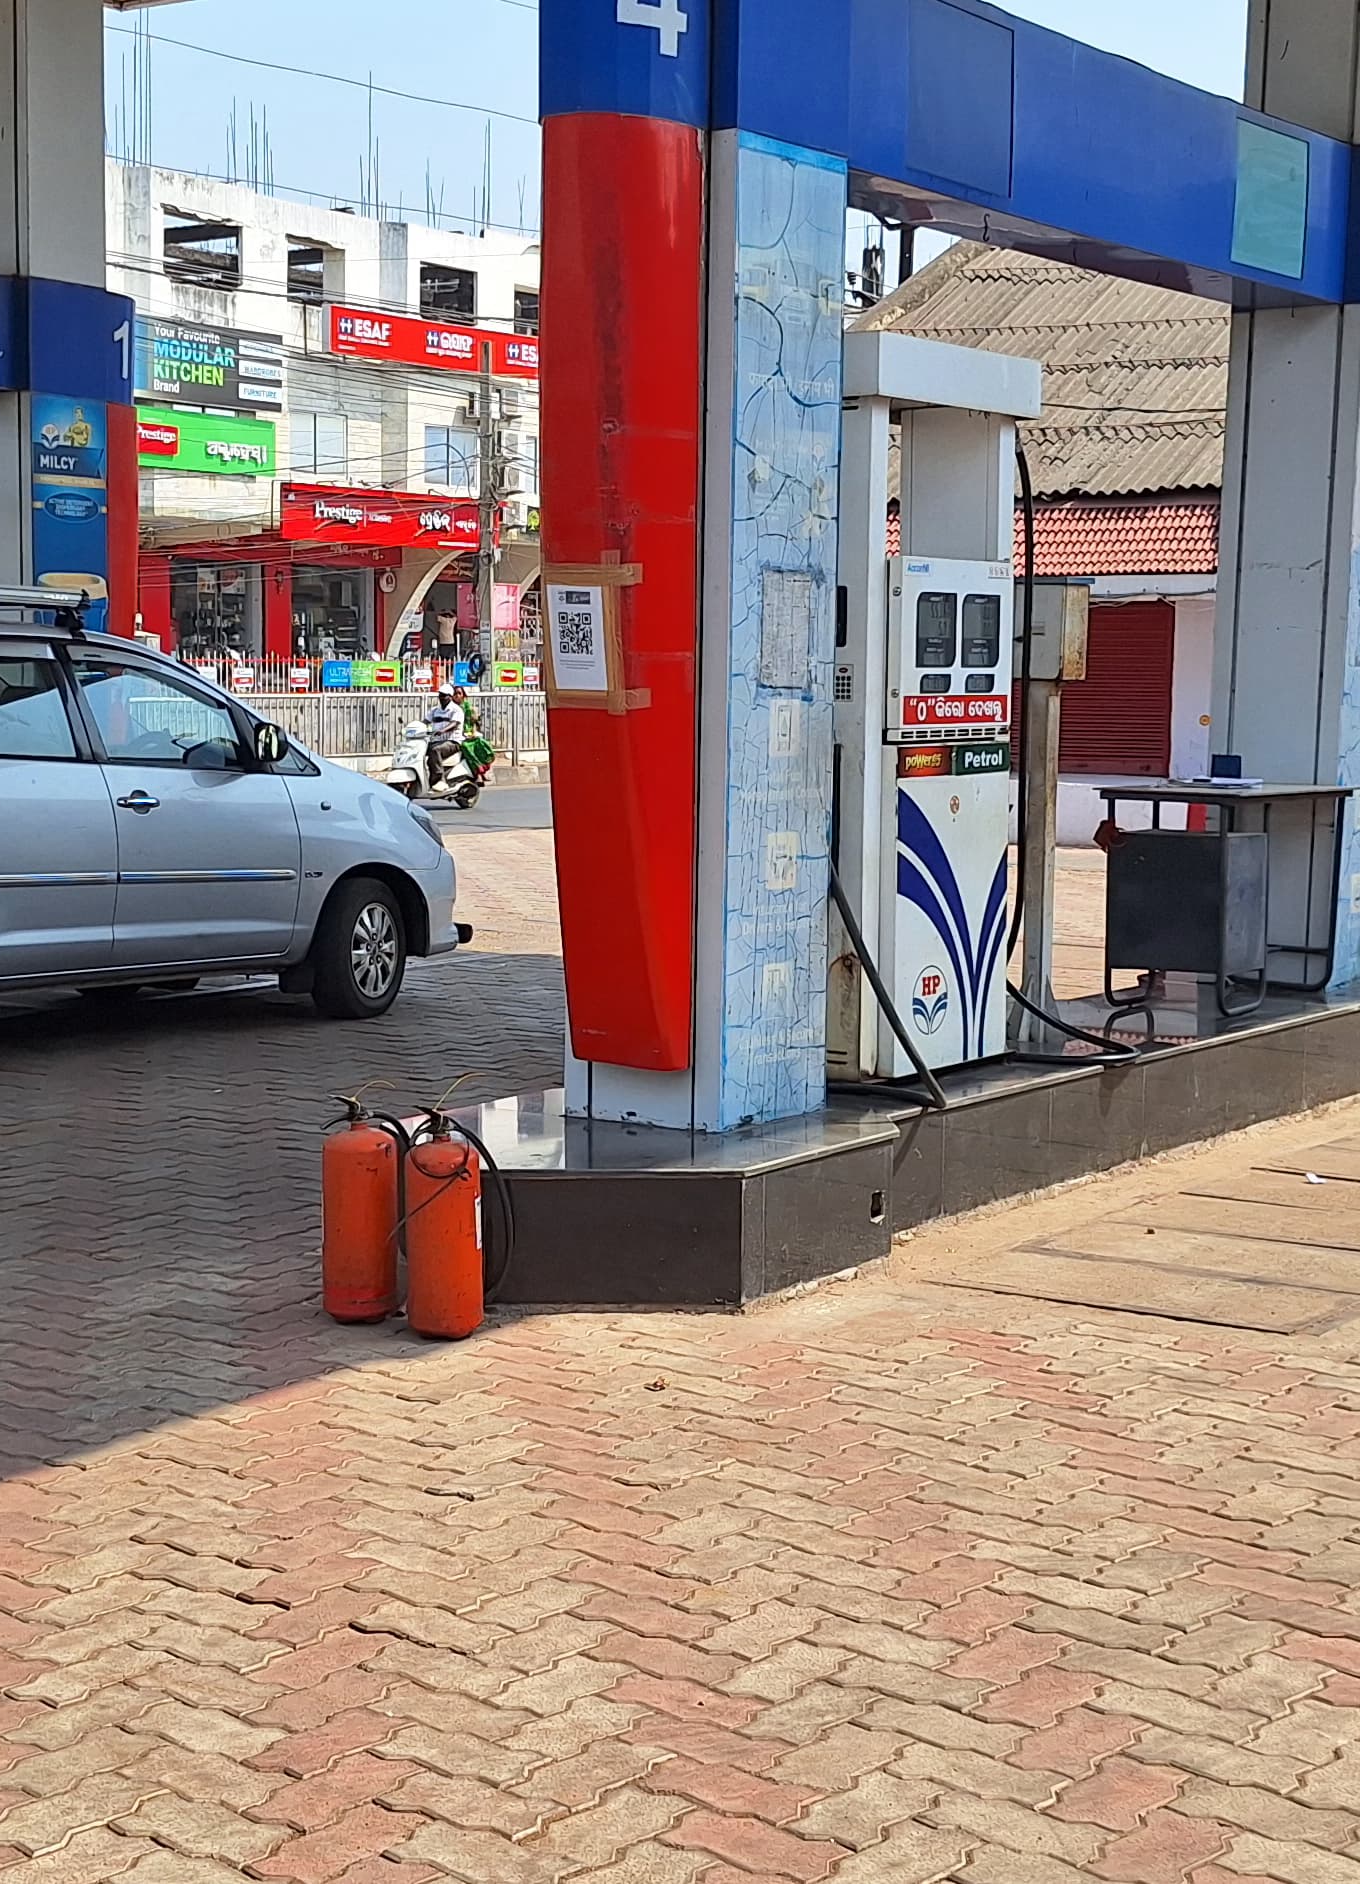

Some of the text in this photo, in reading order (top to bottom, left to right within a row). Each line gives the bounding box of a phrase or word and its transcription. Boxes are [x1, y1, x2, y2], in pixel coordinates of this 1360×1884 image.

[617, 0, 687, 57] 4
[154, 323, 175, 337] Your
[355, 319, 392, 340] ESAF
[112, 320, 129, 380] 1
[154, 338, 235, 367] MODULAR
[154, 359, 224, 387] KITCHEN
[154, 379, 180, 393] Brand
[40, 454, 76, 471] MILCY
[315, 500, 363, 524] Prestige
[964, 749, 1003, 768] Petrol
[922, 975, 941, 996] HP
